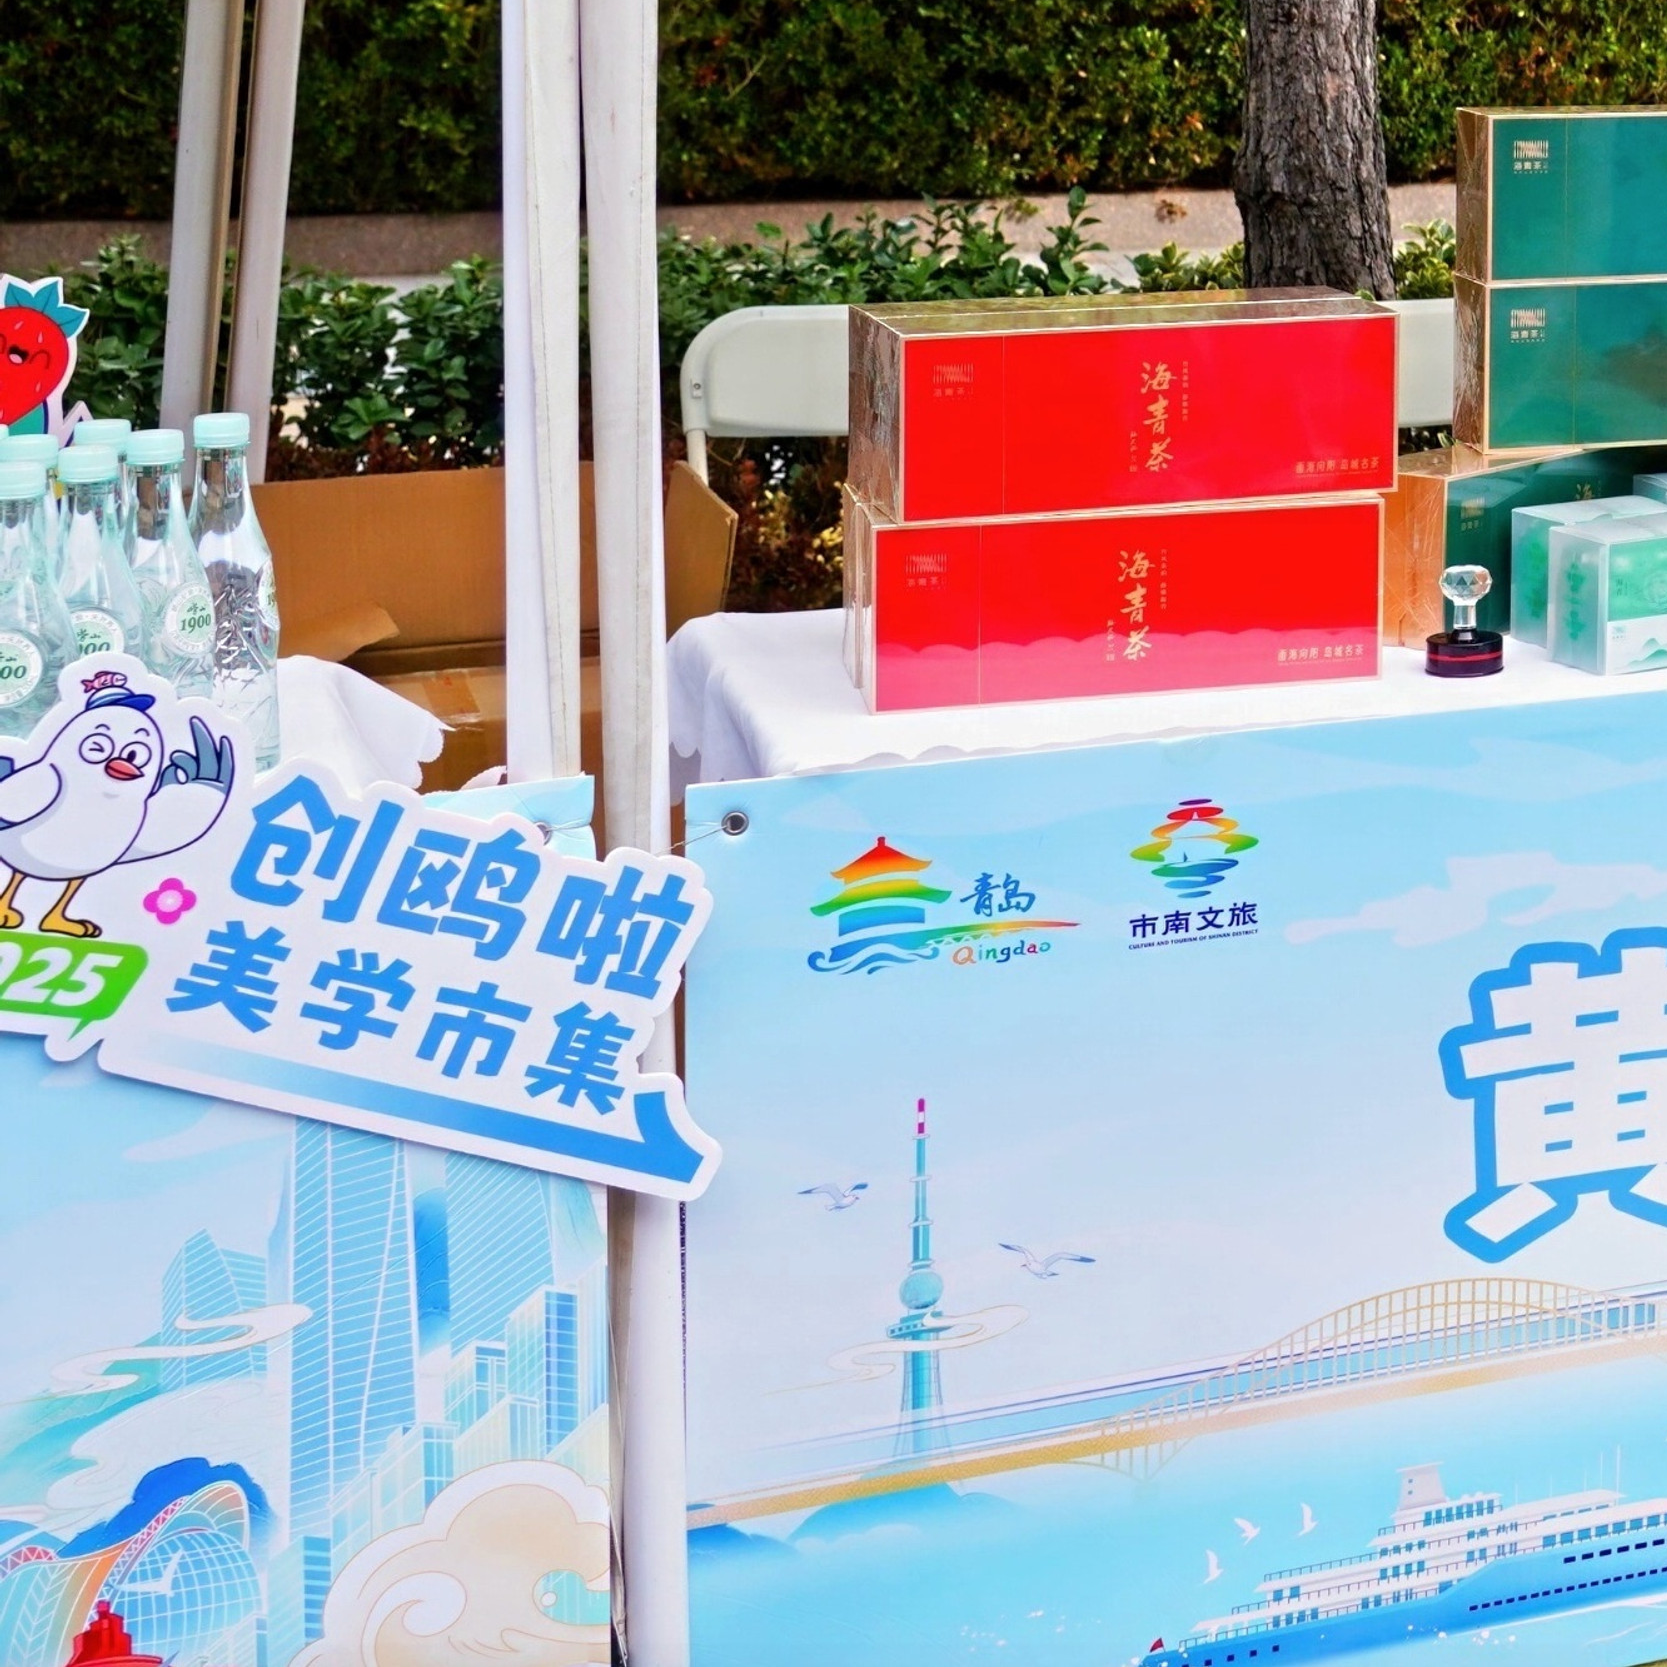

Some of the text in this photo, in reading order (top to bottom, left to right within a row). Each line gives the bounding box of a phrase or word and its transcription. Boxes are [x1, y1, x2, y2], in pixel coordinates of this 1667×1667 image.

[1140, 360, 1178, 473] 海青茶
[180, 614, 212, 634] 1900
[1117, 548, 1156, 662] 海青茶
[229, 774, 695, 1001] 创鸥啦
[960, 872, 1036, 917] 青岛
[1129, 901, 1258, 939] 市南文旅
[952, 940, 1051, 965] Qingdao
[166, 920, 638, 1118] 美学市集
